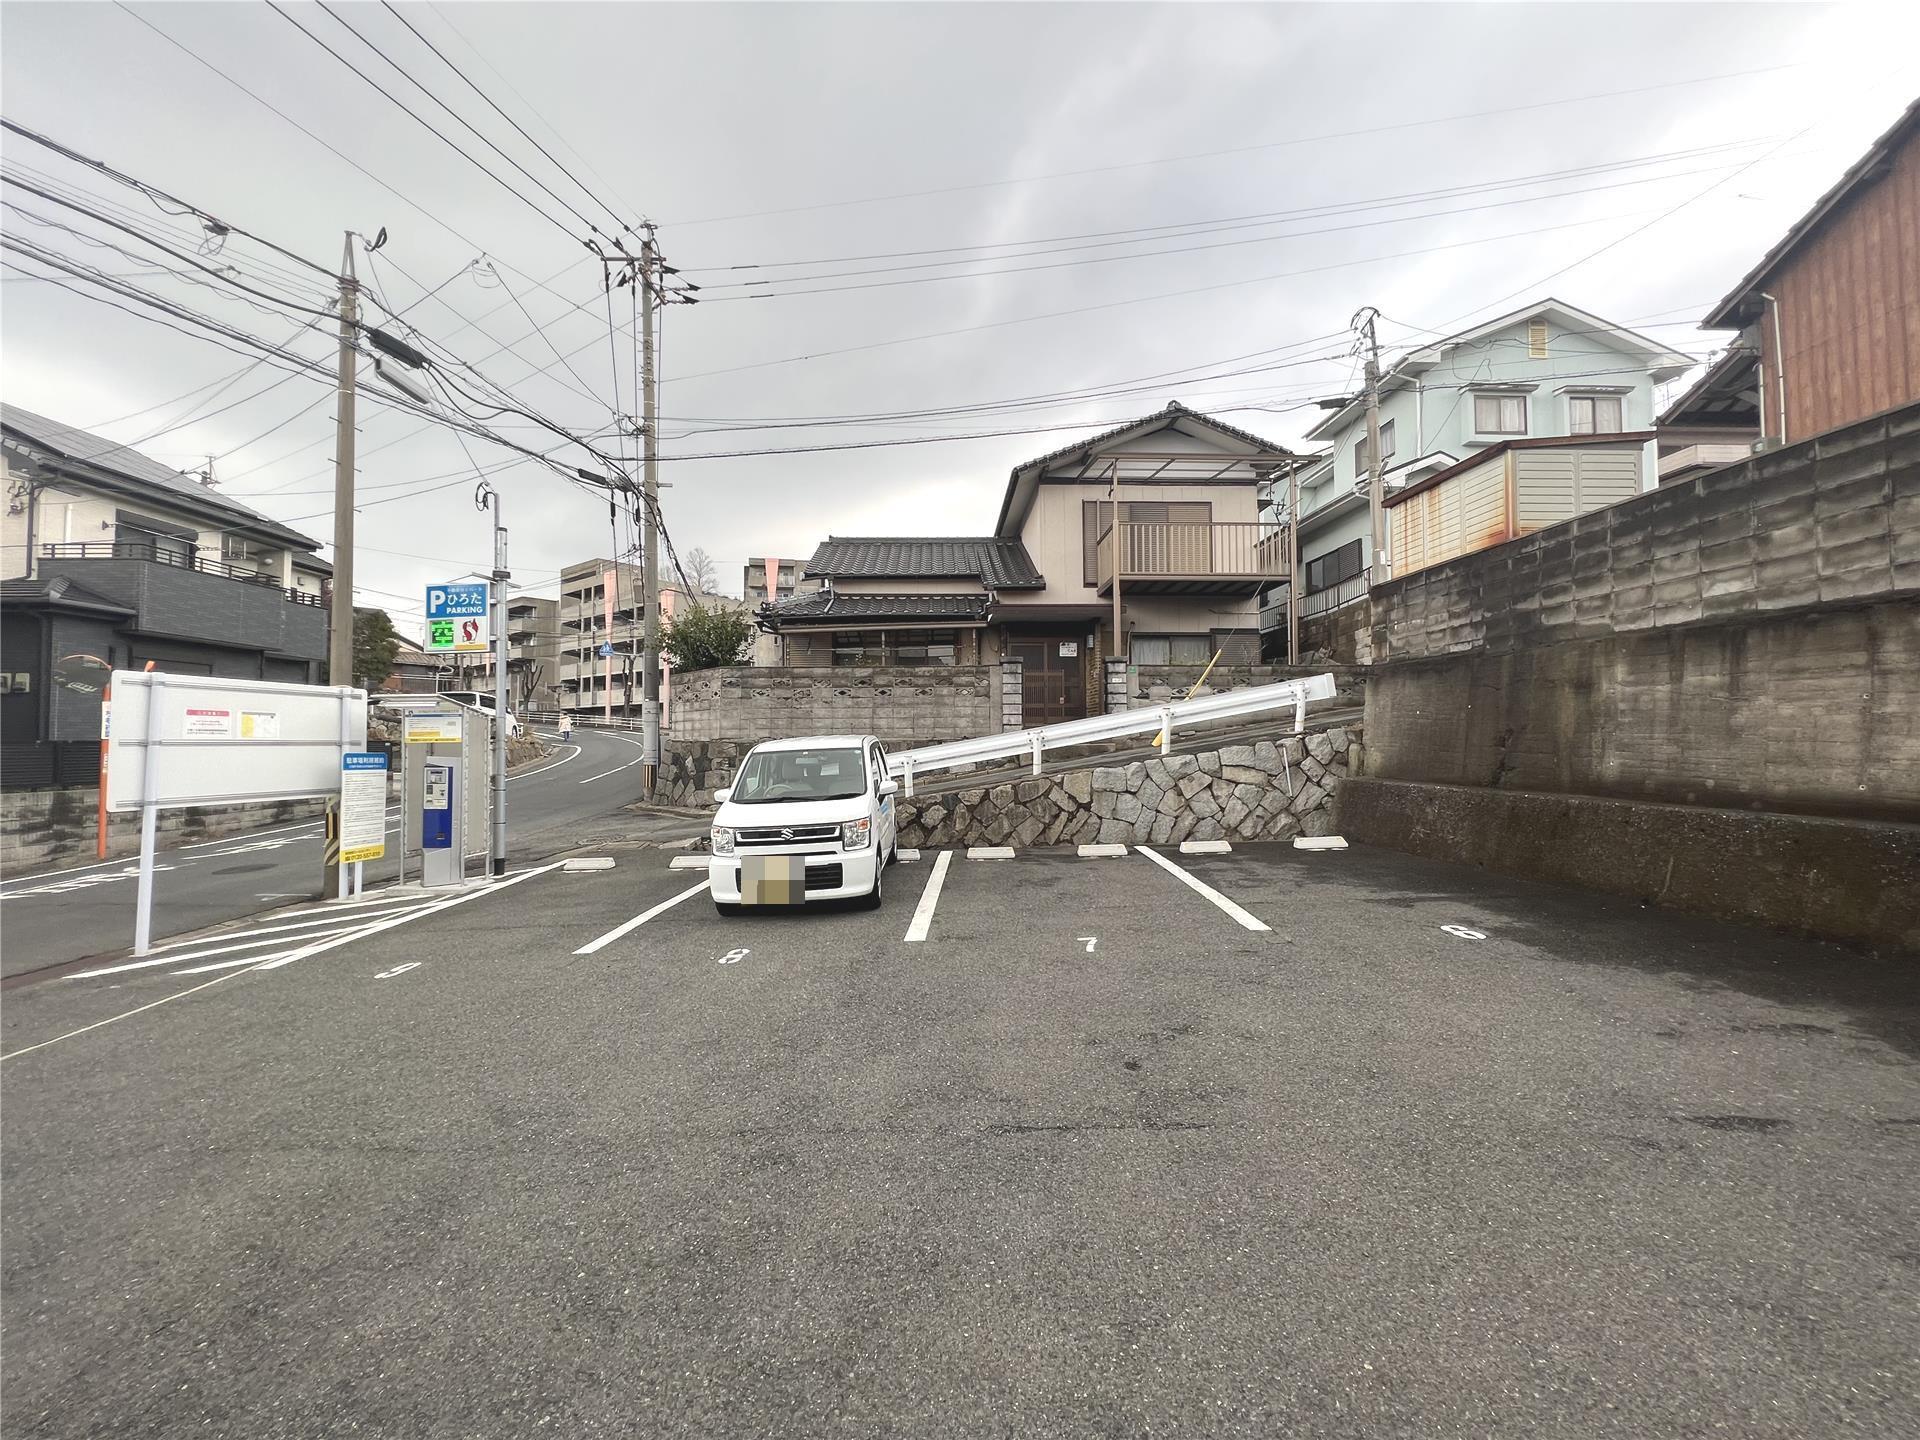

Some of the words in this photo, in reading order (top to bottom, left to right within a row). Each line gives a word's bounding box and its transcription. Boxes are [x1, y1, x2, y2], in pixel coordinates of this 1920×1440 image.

[430, 590, 446, 613] P
[447, 593, 482, 605] ひろた
[446, 606, 483, 614] PARKING
[1076, 937, 1098, 953] 7
[718, 948, 751, 964] 8
